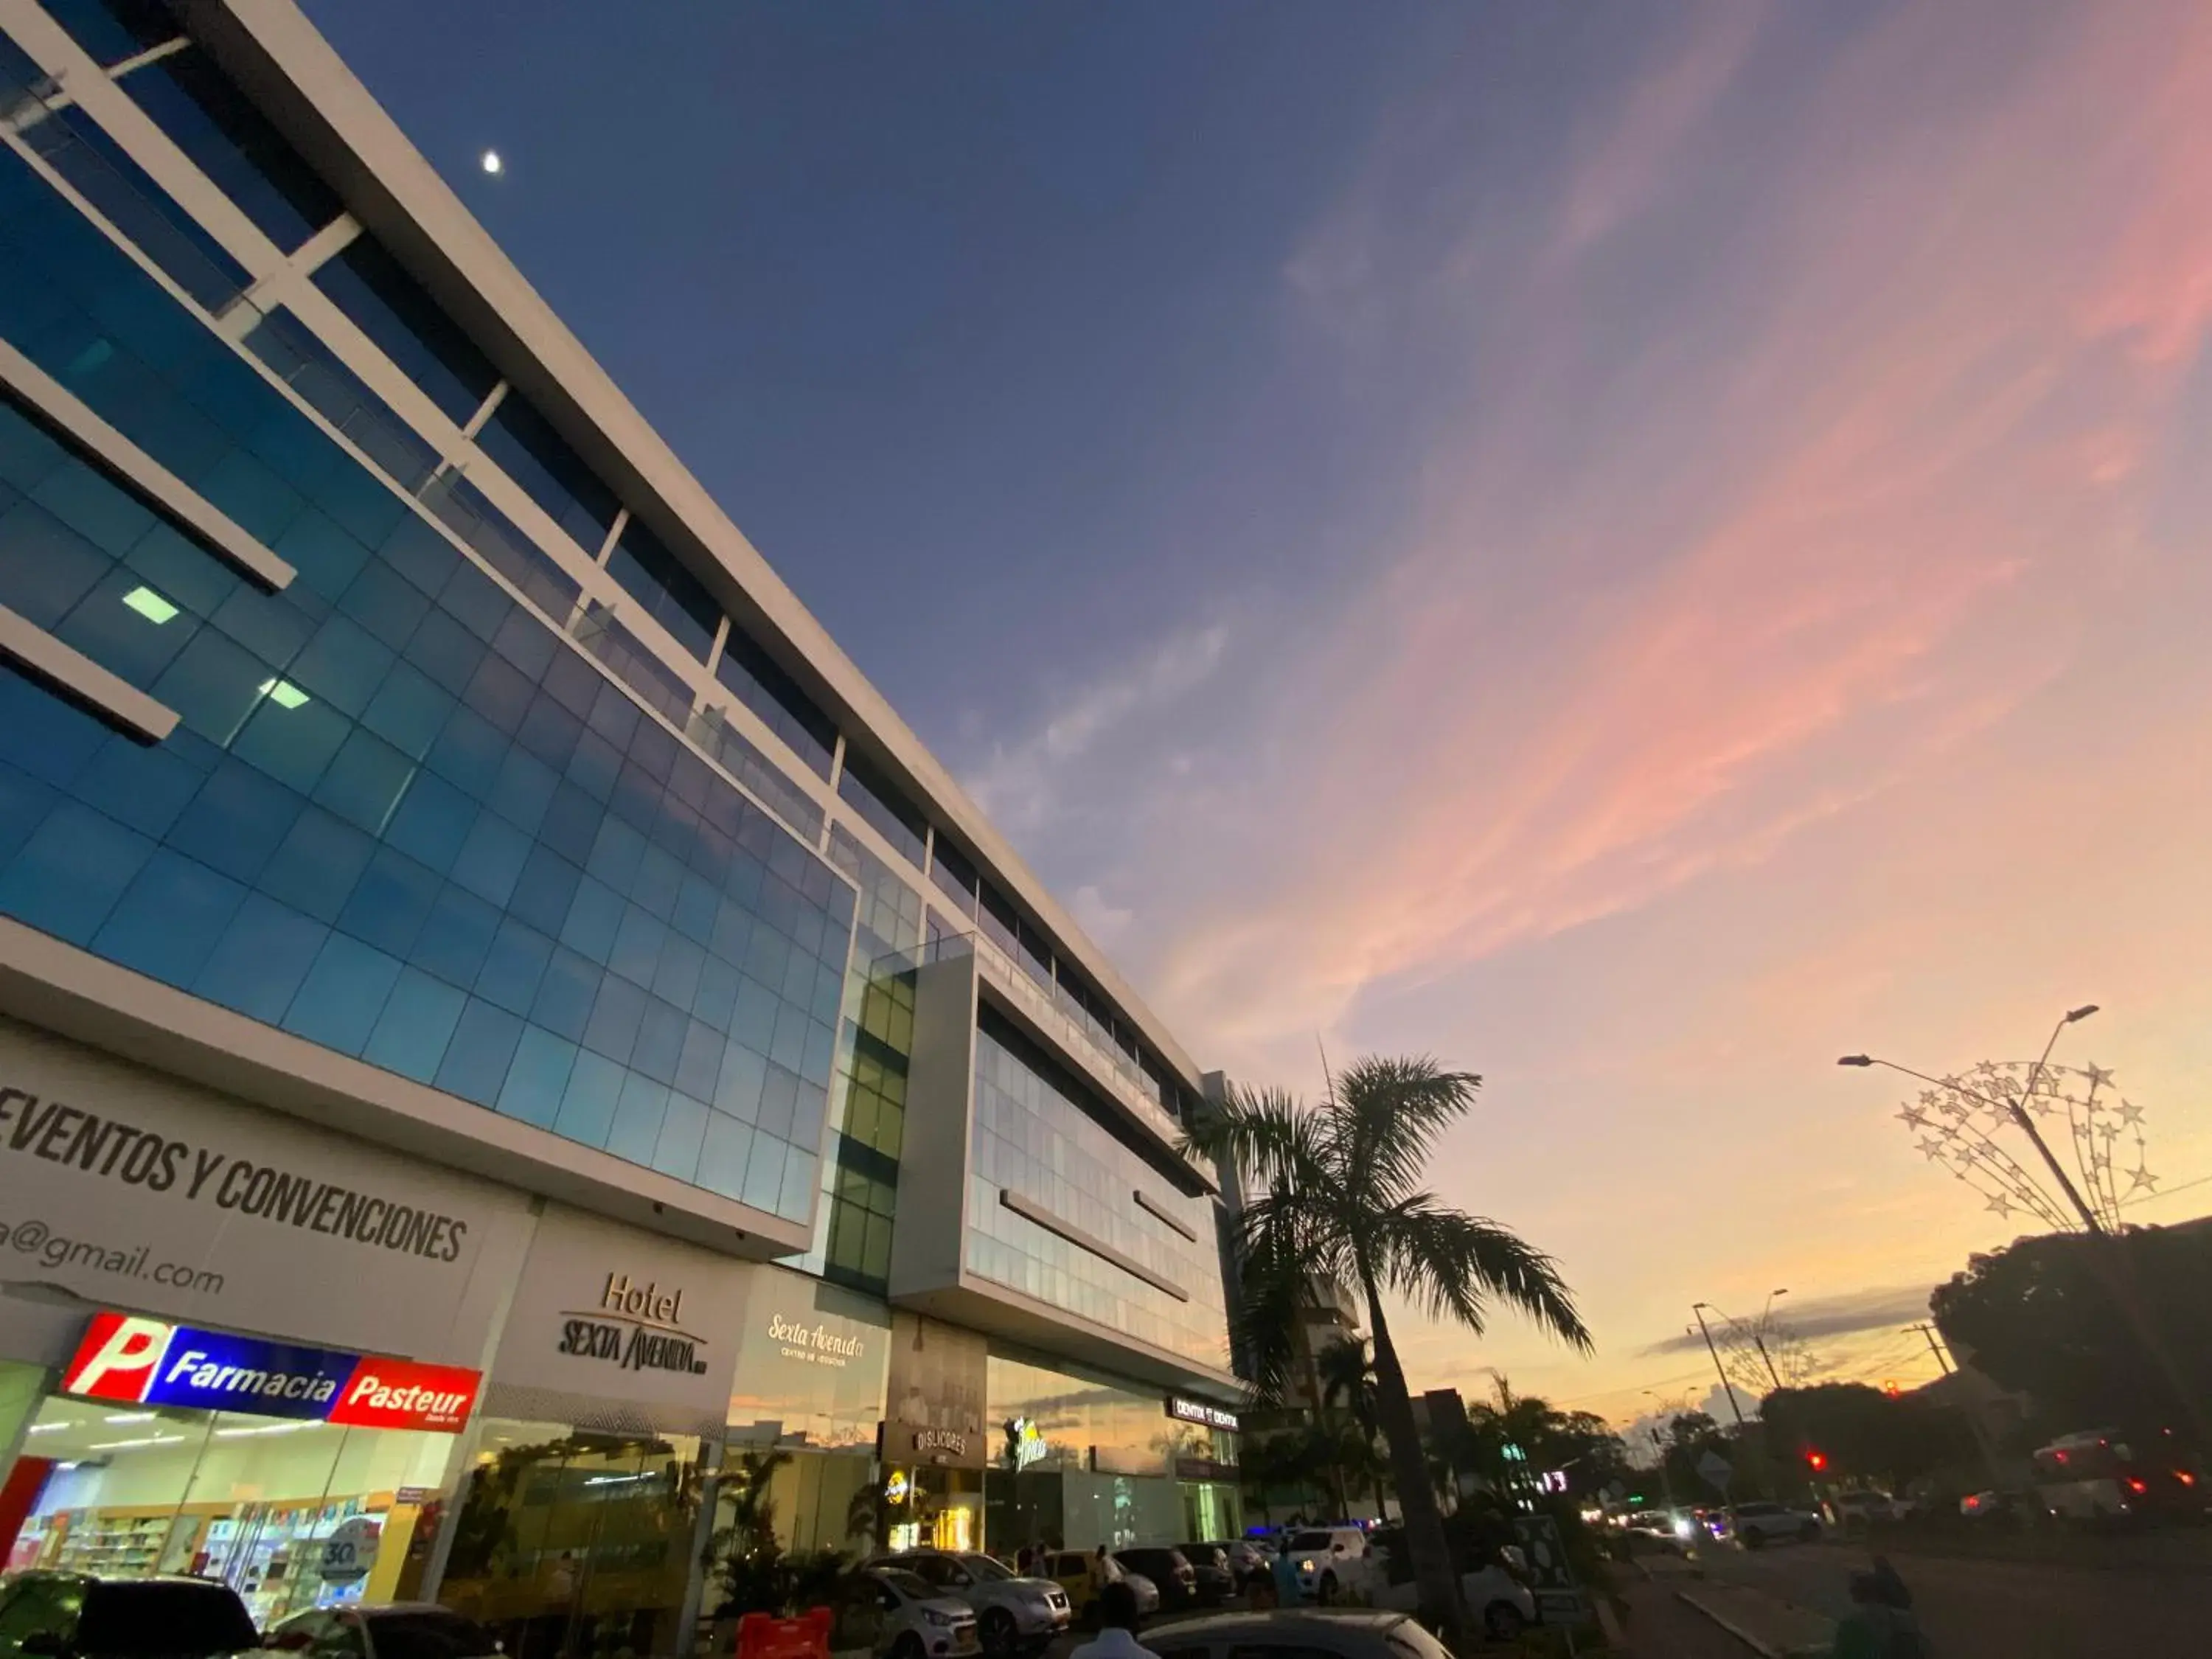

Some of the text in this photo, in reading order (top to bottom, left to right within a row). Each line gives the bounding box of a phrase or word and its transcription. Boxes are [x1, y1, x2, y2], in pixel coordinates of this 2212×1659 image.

[186, 1148, 225, 1200] Y
[215, 1160, 467, 1262] CONVENCIONES
[600, 1272, 683, 1324] Hotel
[69, 1316, 172, 1394] P
[557, 1318, 695, 1372] SEXTA AVENIDA
[768, 1313, 864, 1357] Sexta Avenida
[165, 1351, 467, 1415] Farmacia Pasteur
